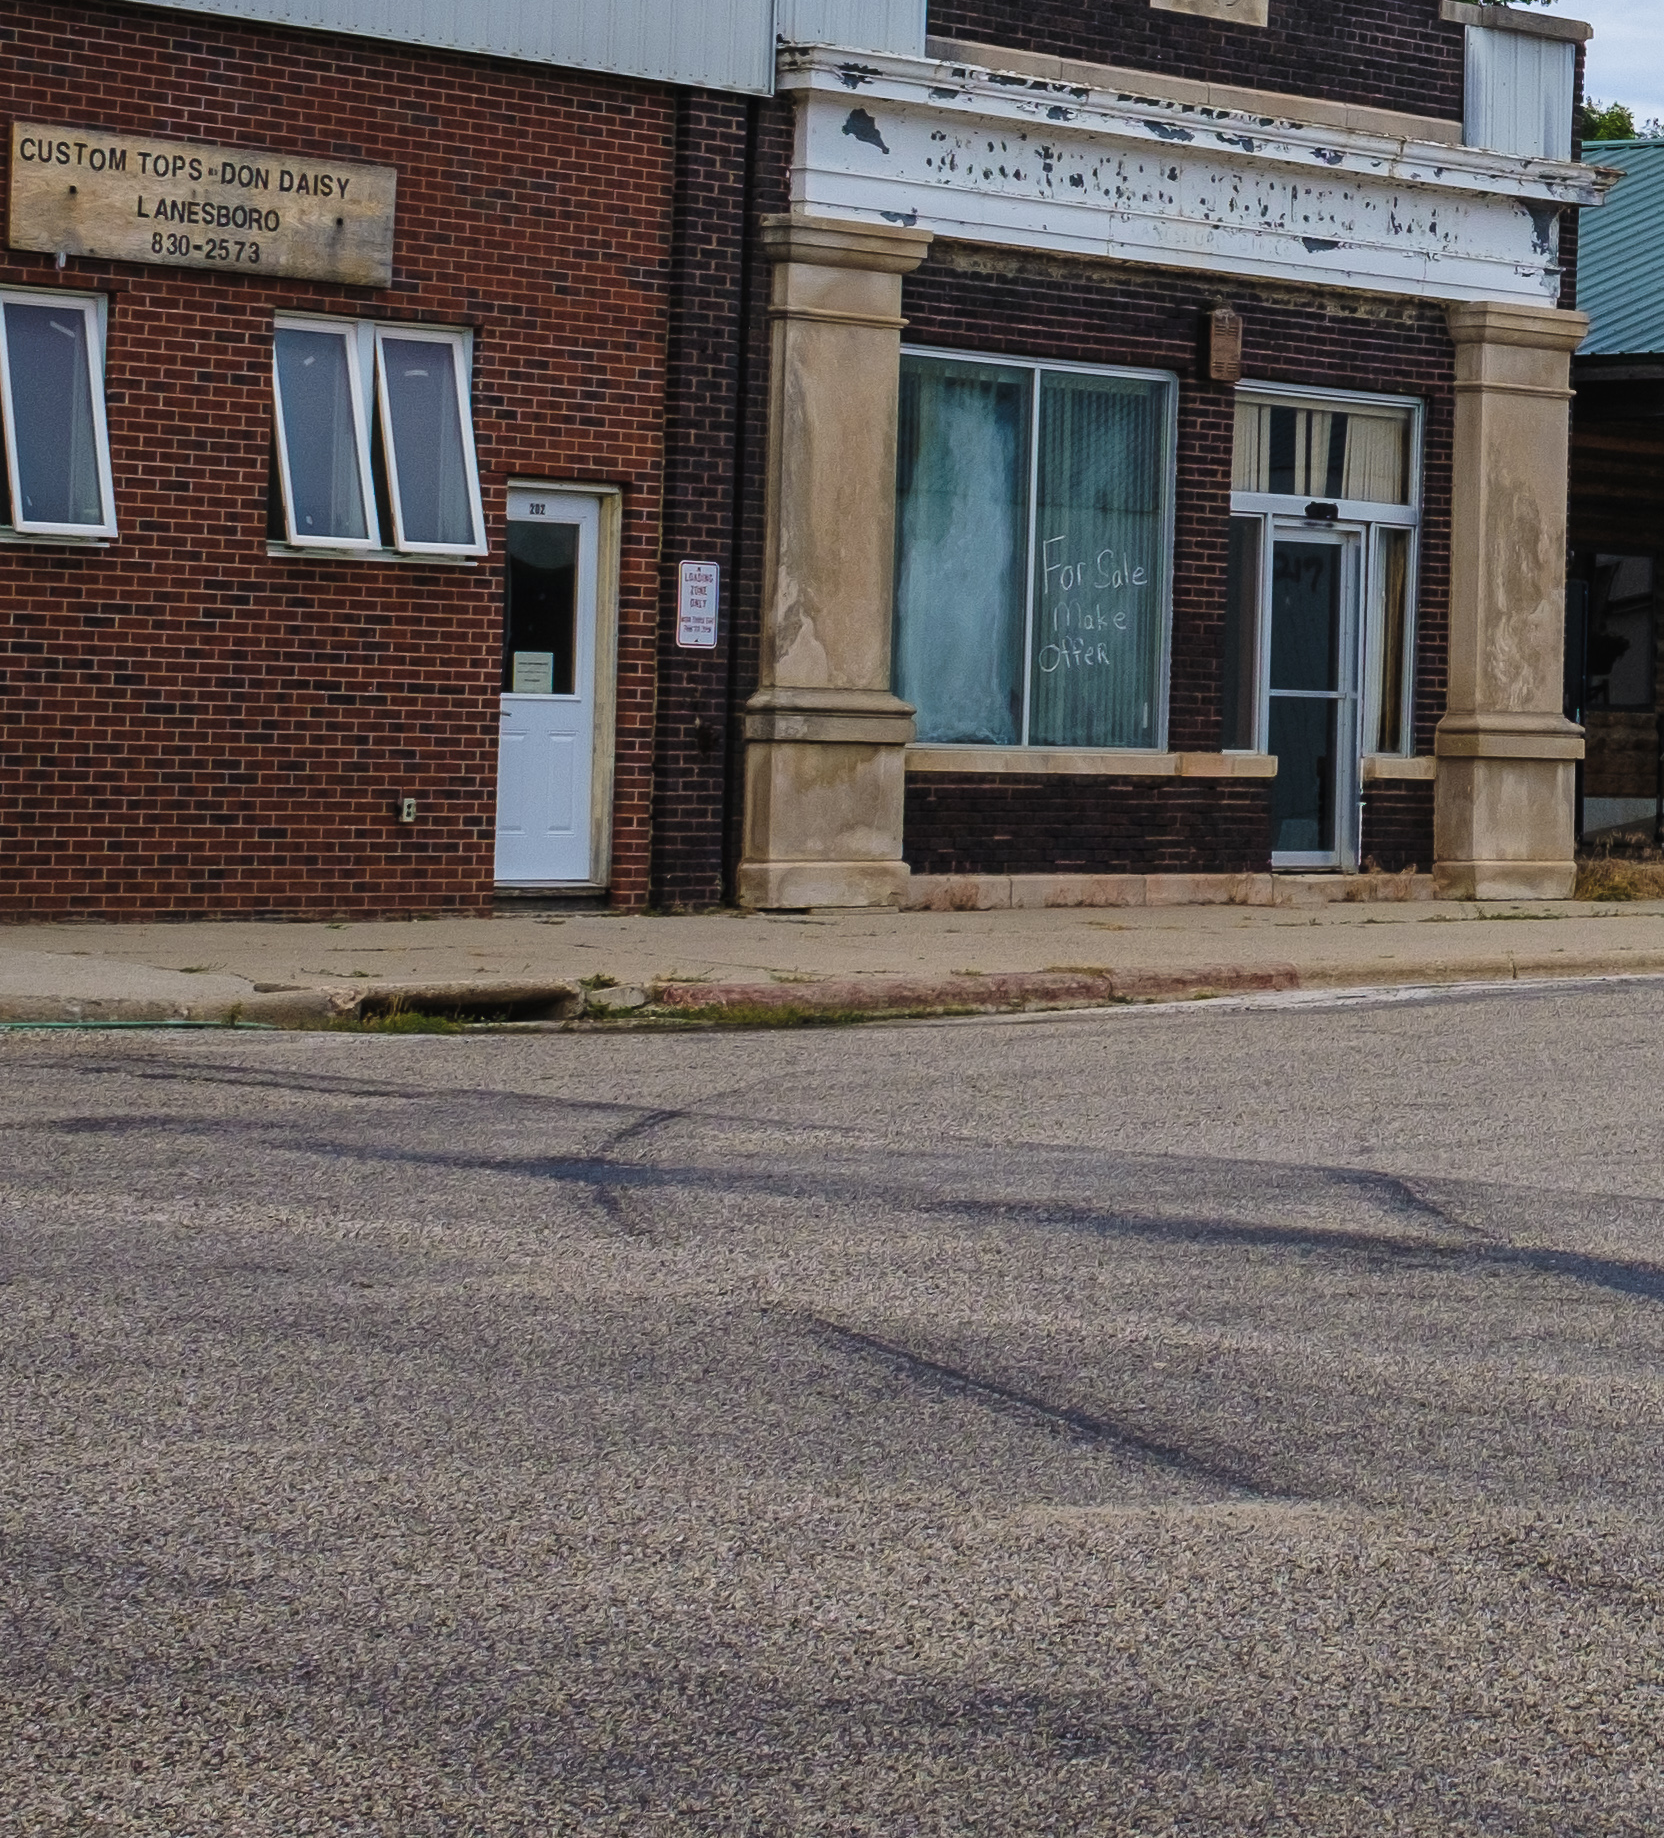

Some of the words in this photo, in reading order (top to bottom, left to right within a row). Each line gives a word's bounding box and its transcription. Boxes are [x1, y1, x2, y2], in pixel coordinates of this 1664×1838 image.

[19, 137, 127, 172] CUSTOM
[278, 168, 351, 200] DAISY
[136, 195, 280, 233] LANESBORO
[151, 231, 261, 264] 830-2573
[684, 572, 714, 583] LOADING
[1042, 535, 1087, 595] For
[1094, 548, 1148, 589] Sale
[689, 598, 708, 609] ONLY
[690, 585, 708, 596] ZONE
[1053, 599, 1127, 631] Make
